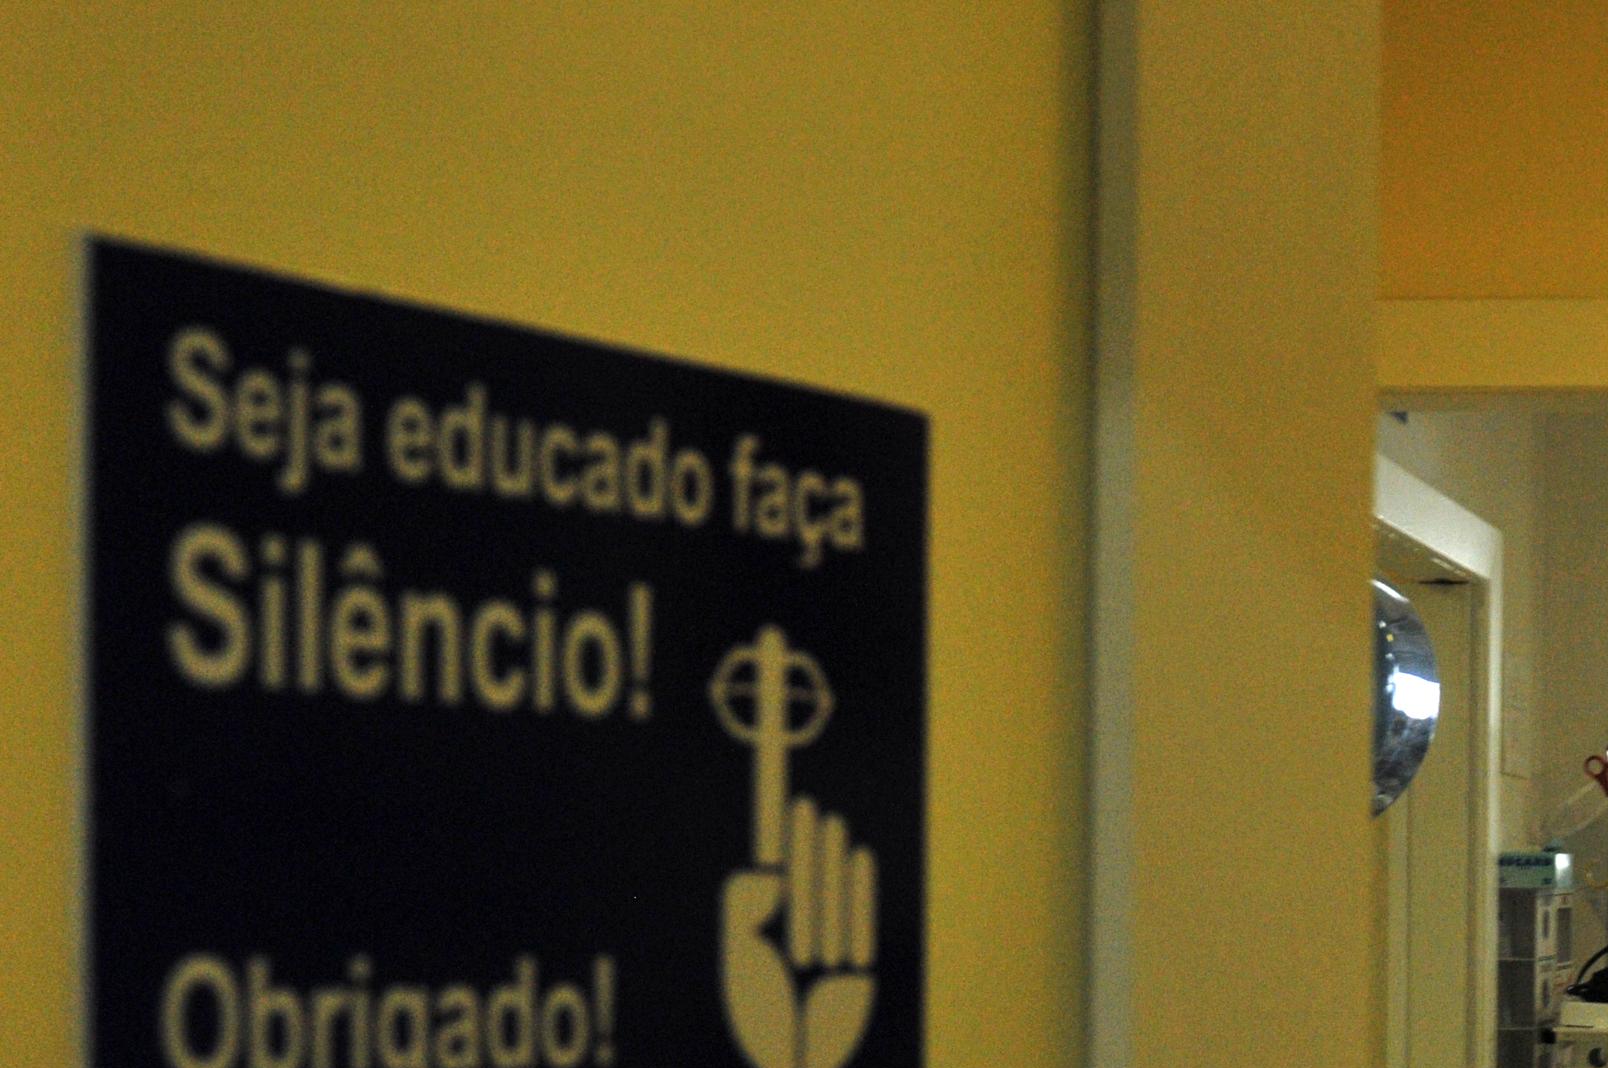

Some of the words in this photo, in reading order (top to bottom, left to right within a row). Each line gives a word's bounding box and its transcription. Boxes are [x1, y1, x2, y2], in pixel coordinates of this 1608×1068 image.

[166, 326, 364, 494] Seja
[386, 382, 714, 528] educado
[728, 432, 866, 568] faça
[166, 520, 654, 720] Silêncio!
